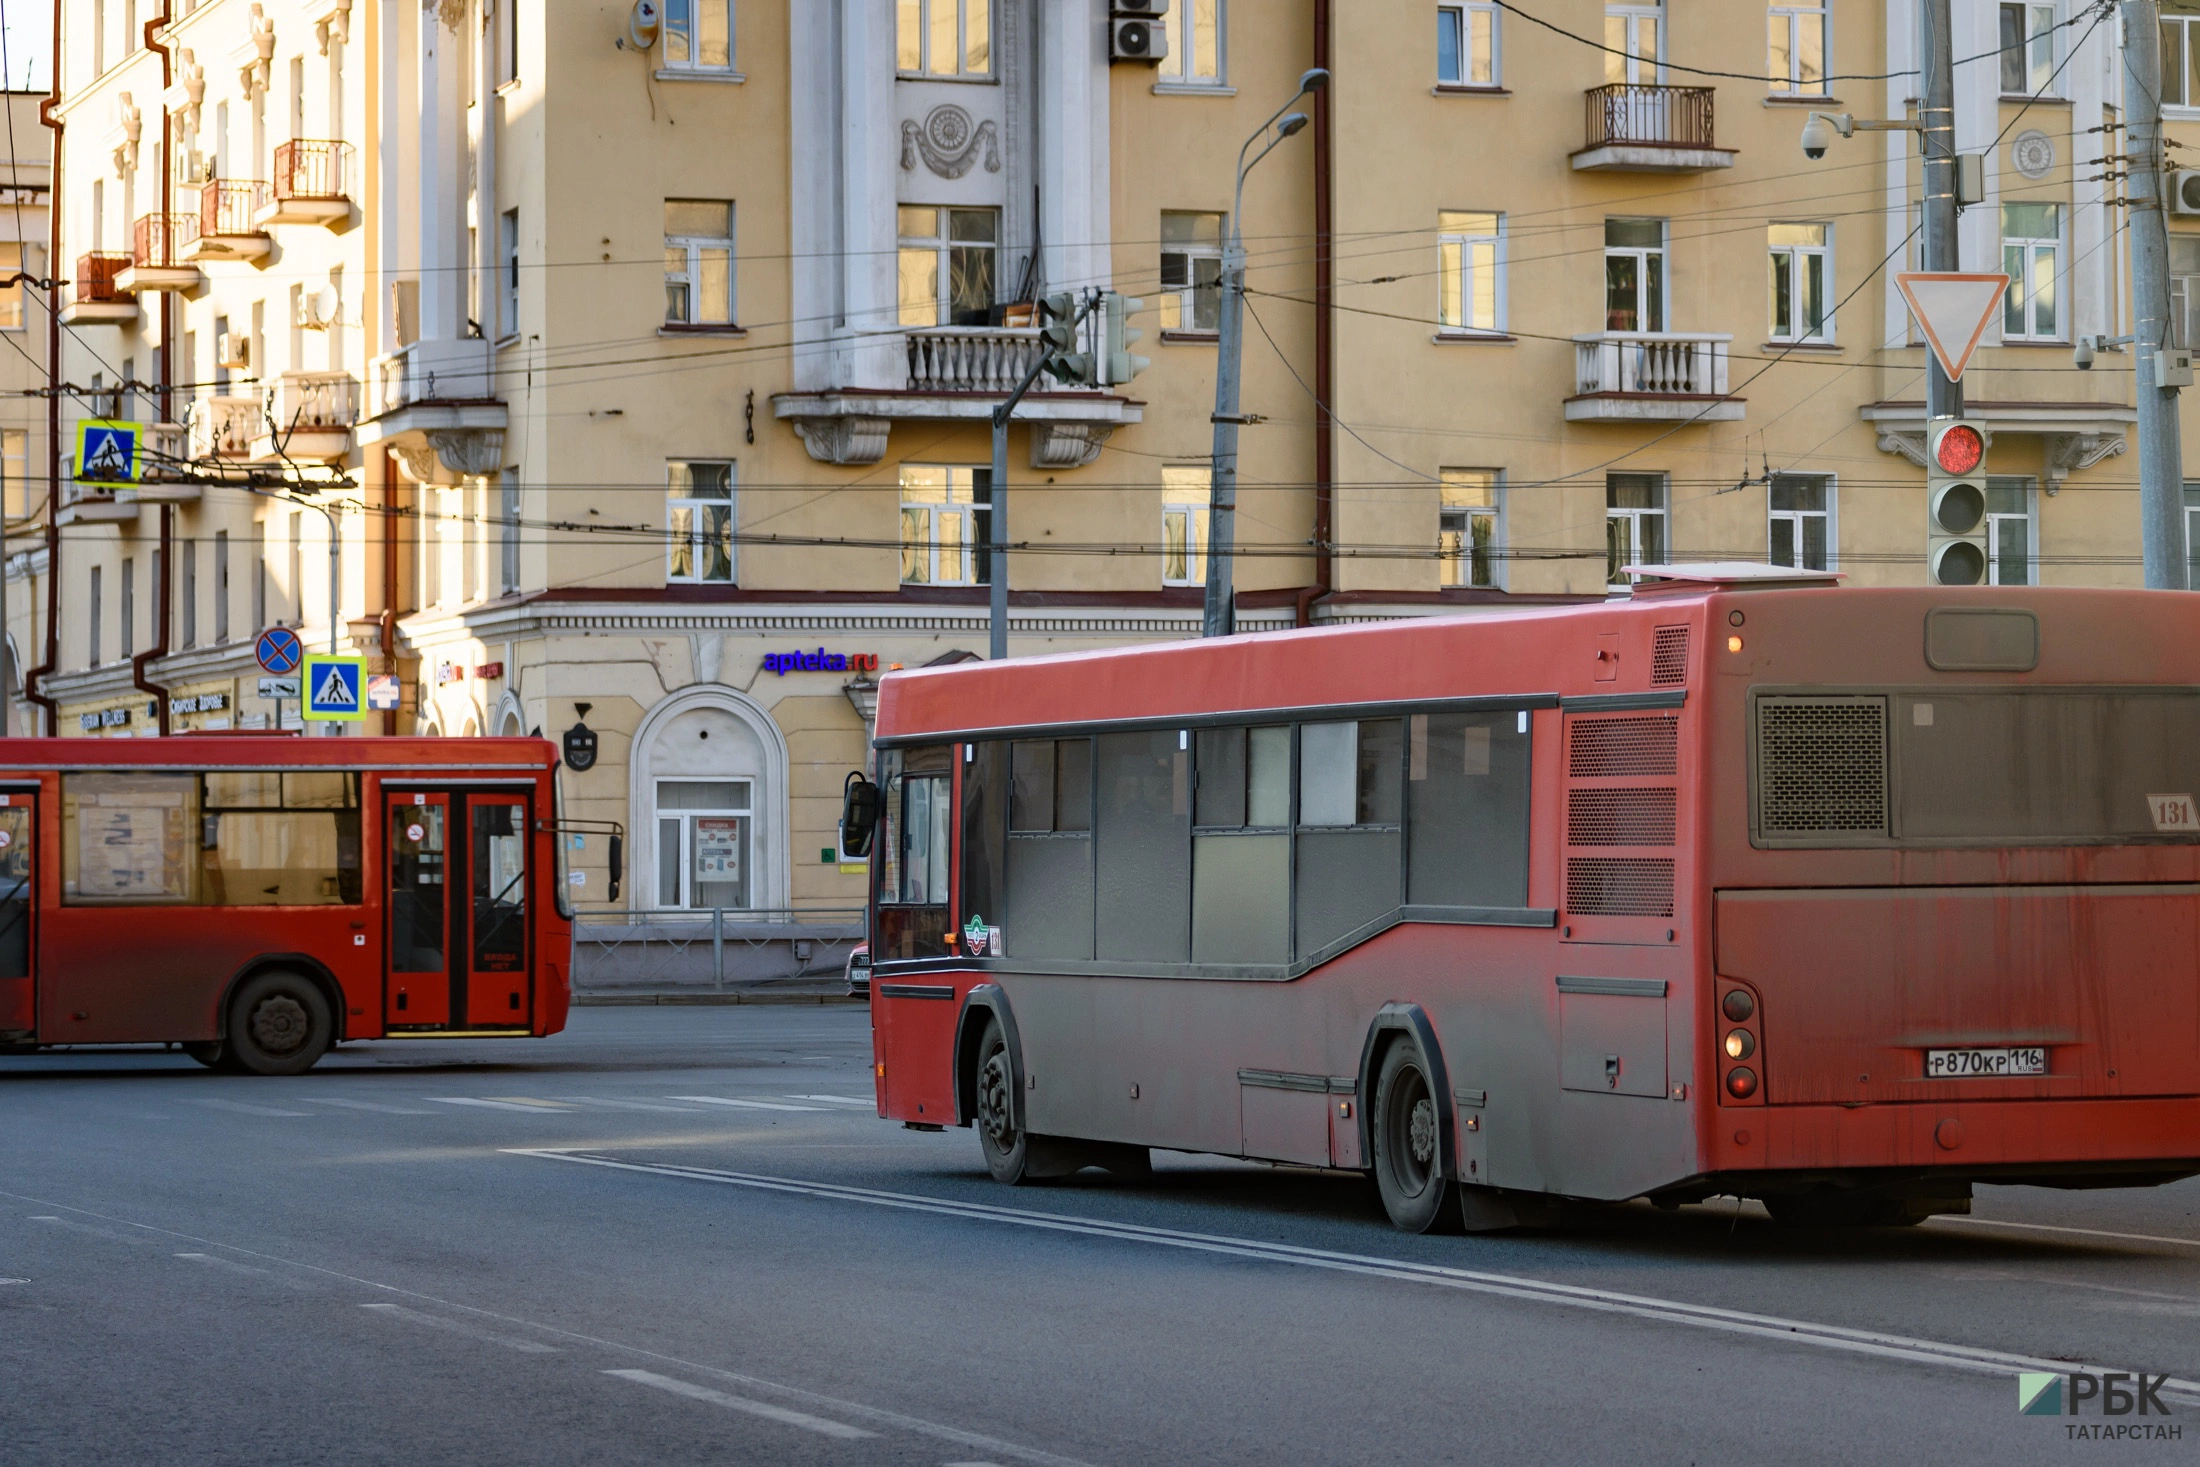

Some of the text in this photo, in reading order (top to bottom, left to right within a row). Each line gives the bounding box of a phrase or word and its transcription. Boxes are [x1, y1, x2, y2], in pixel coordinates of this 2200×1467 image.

[764, 647, 878, 676] apteka.ru
[2159, 801, 2188, 824] 131
[991, 932, 1000, 950] 131
